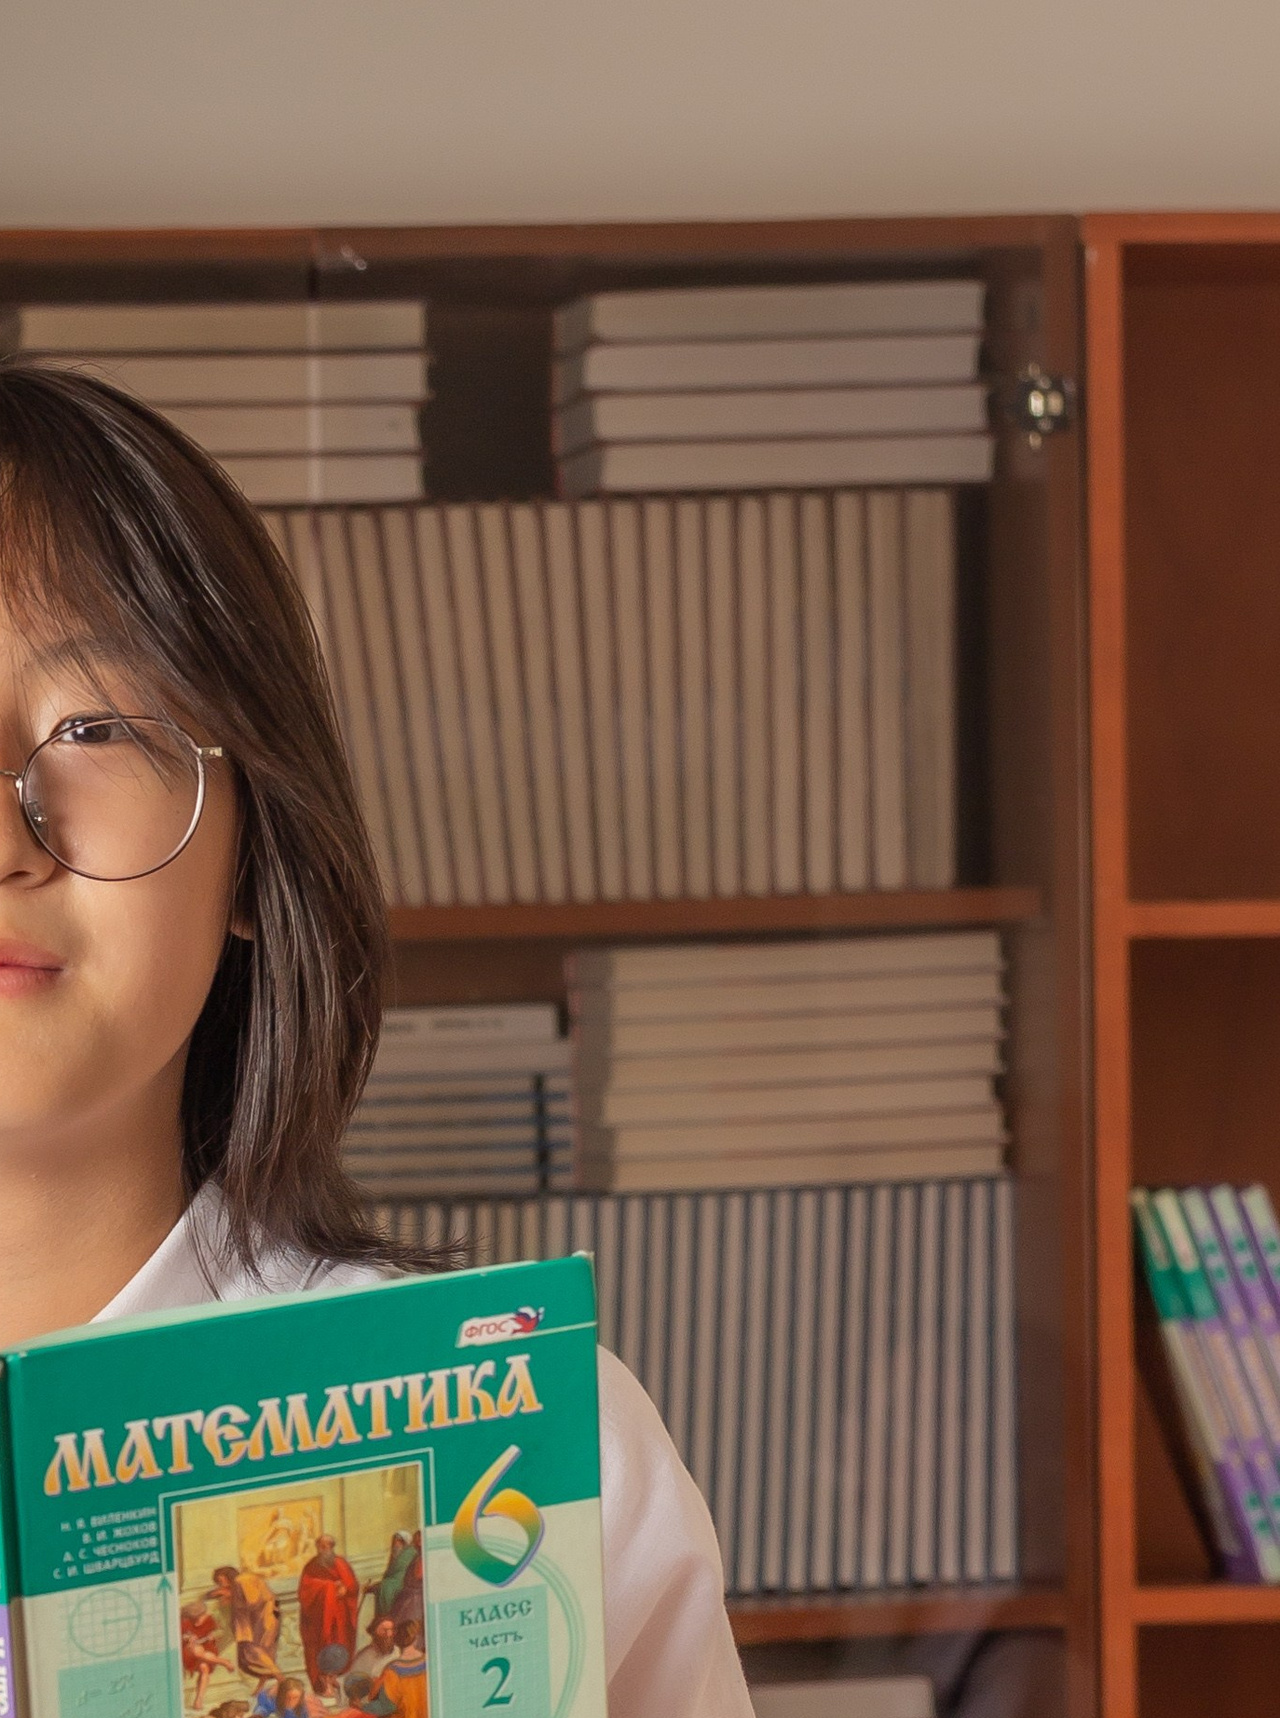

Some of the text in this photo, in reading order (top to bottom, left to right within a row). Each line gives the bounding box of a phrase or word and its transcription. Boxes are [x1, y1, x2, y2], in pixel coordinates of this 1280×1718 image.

[464, 1319, 508, 1338] ФГОС
[43, 1353, 544, 1498] МАТЕМАТИКА
[451, 1443, 547, 1589] 6
[92, 1536, 159, 1557] ЧЕСНОКОВ
[459, 1599, 533, 1627] КЛАСС
[480, 1656, 515, 1710] 2
